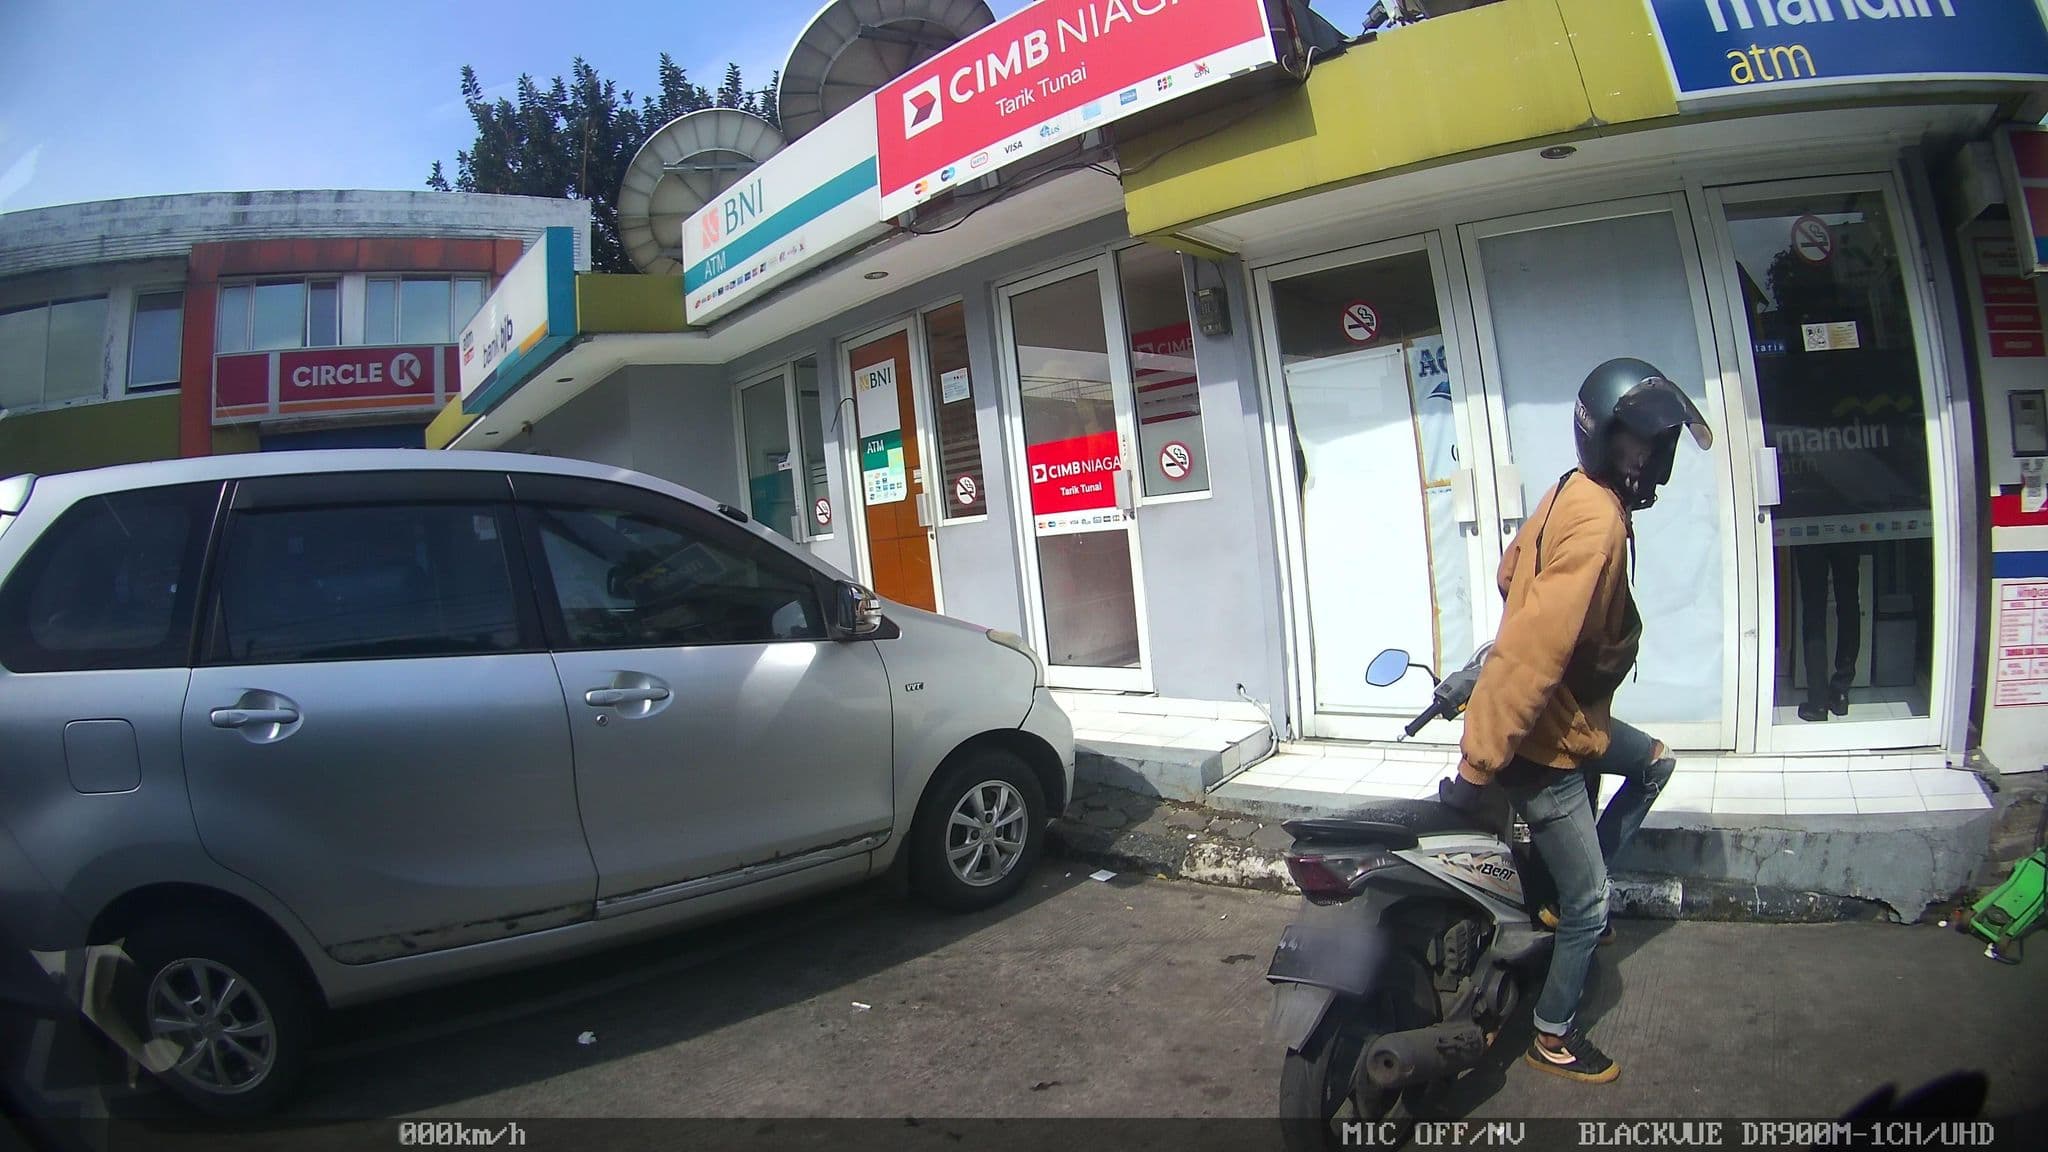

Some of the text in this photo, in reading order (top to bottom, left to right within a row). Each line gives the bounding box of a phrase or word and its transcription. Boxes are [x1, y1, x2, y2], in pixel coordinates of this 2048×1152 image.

[949, 0, 1179, 104] CIMB NIA
[1726, 43, 1817, 84] atm
[995, 62, 1088, 117] Tarik Tunai
[1004, 140, 1023, 154] VISA
[725, 178, 763, 236] BNI
[704, 250, 727, 280] ATM
[293, 362, 383, 387] CIRCLE
[869, 367, 892, 389] BNI
[867, 439, 885, 454] ATM
[1048, 456, 1121, 479] CIMB NIAGA
[1060, 481, 1102, 496] Tarik Tunai
